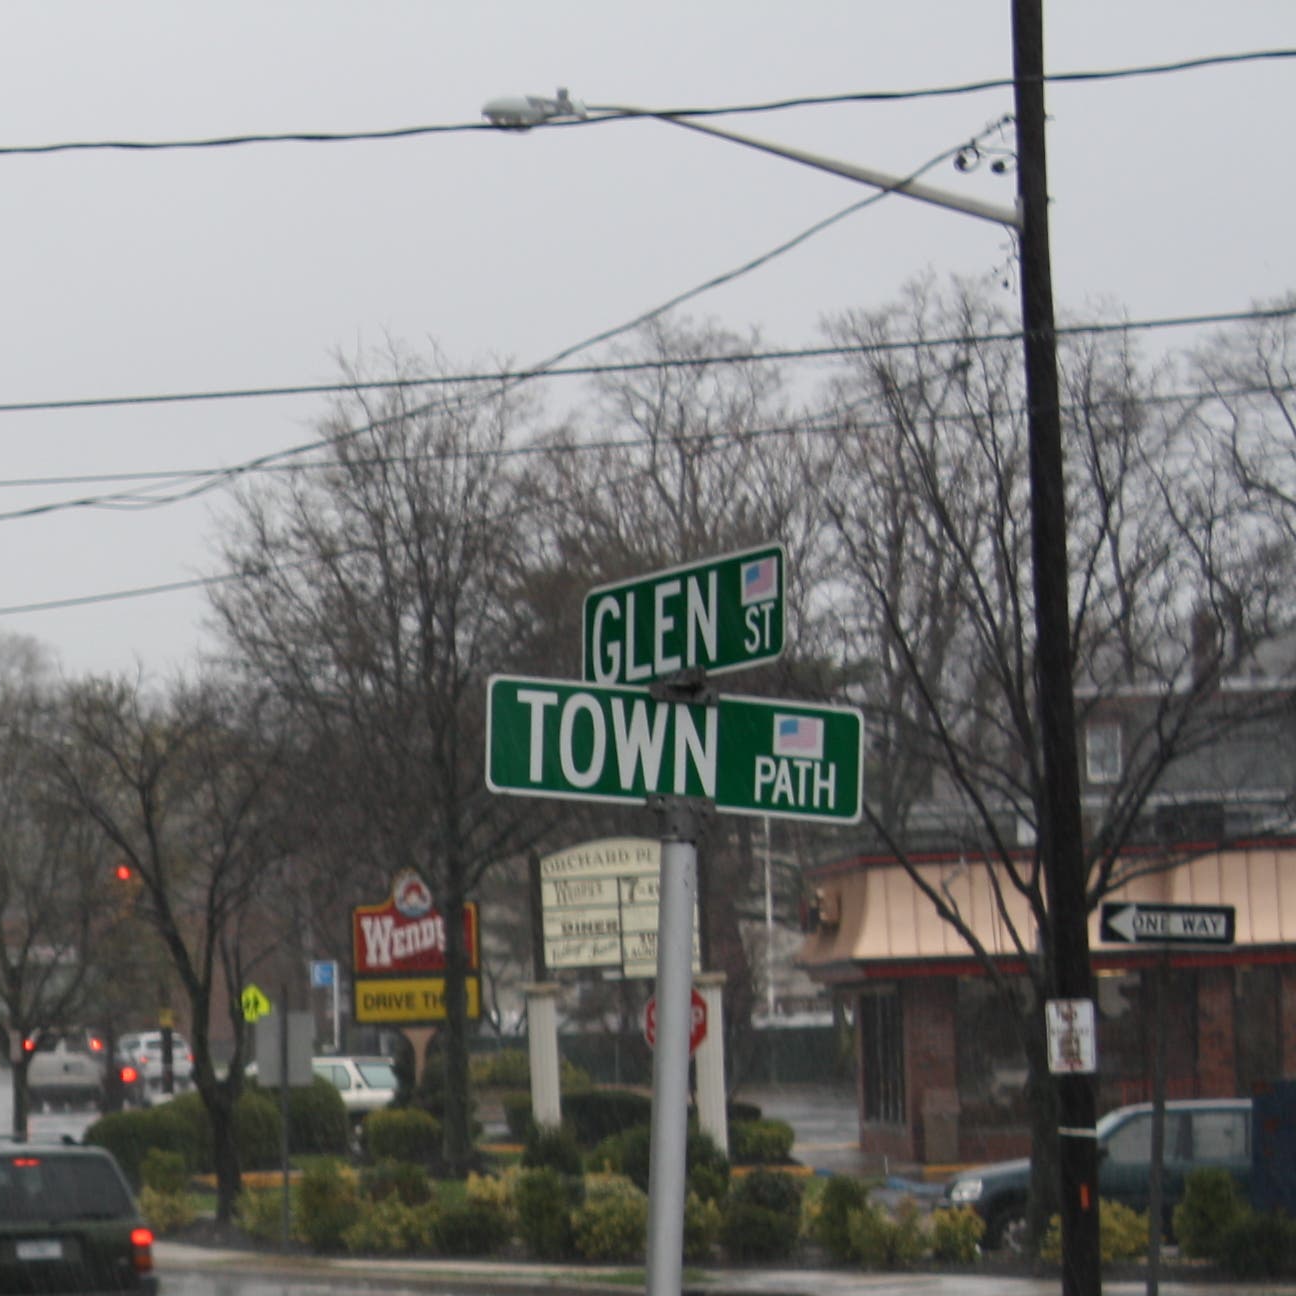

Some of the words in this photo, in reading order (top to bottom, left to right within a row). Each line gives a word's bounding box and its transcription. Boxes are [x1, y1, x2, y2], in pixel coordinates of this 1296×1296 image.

[591, 570, 719, 685] GLEN
[743, 602, 775, 655] ST
[516, 688, 719, 799] TOWN
[754, 754, 836, 809] PATH
[1132, 913, 1171, 932] ONE
[1181, 914, 1221, 933] WAY
[363, 991, 415, 1010] DRIVE
